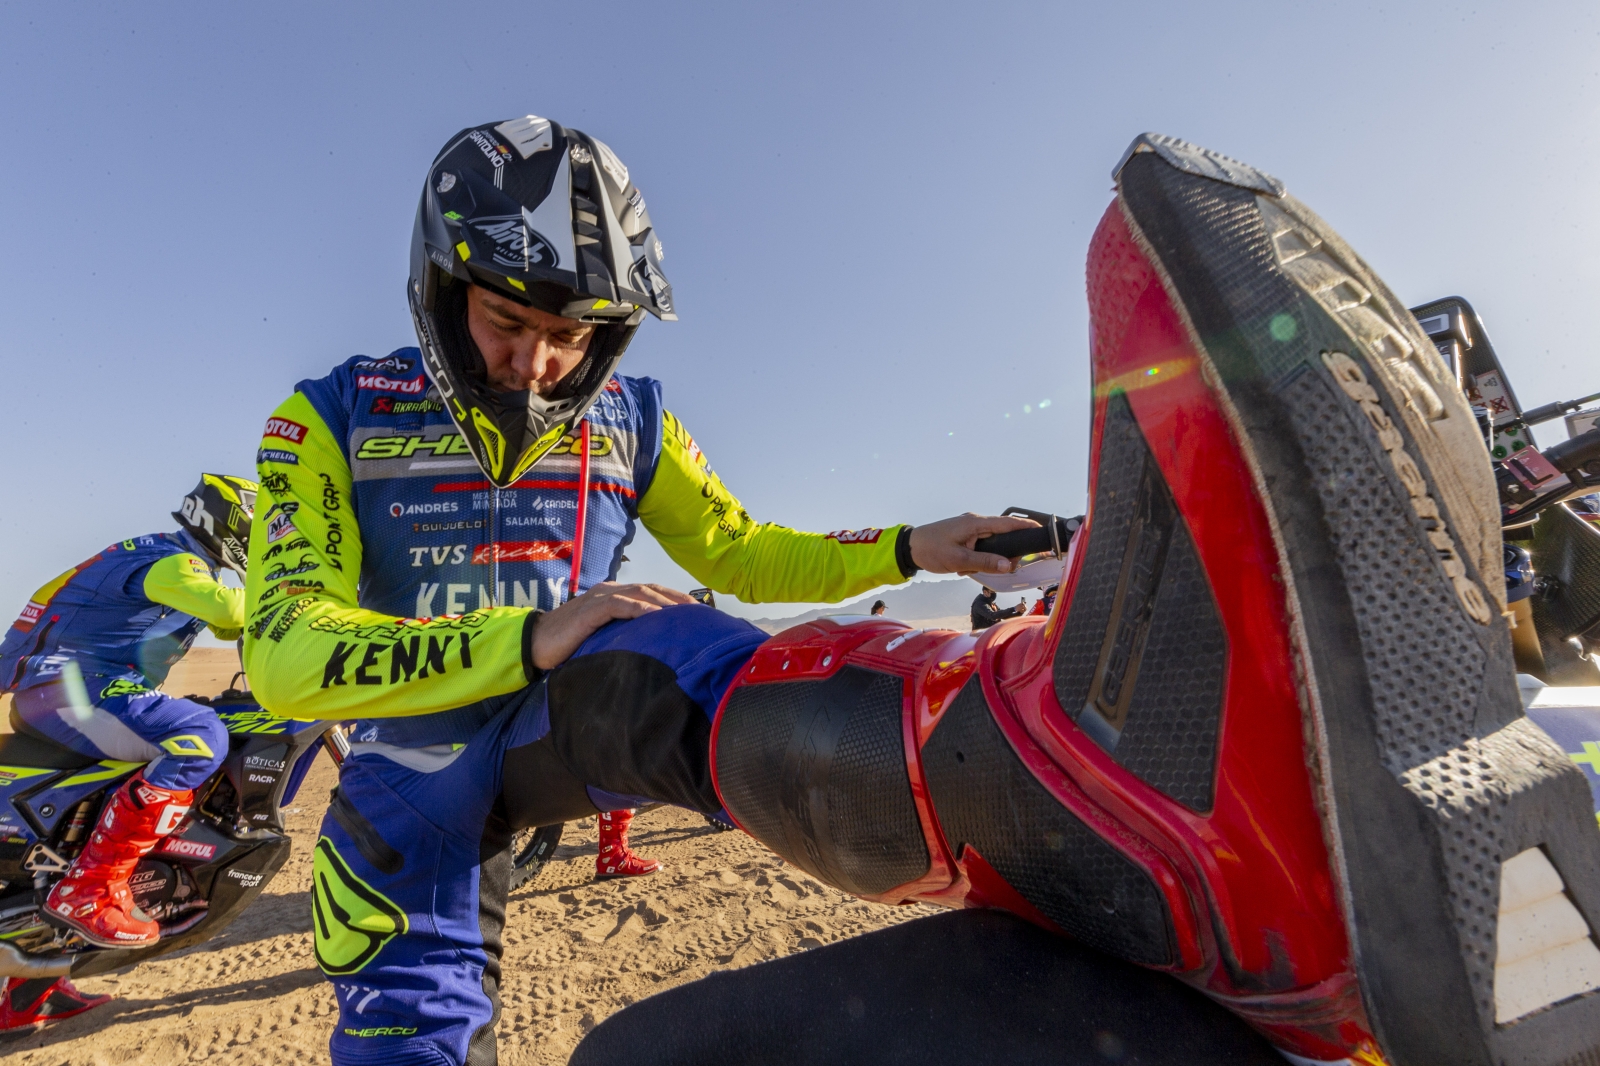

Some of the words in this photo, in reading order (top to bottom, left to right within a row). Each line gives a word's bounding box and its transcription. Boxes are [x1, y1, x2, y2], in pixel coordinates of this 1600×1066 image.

[470, 130, 505, 168] SANTOLINO
[430, 250, 454, 271] AIROH
[357, 376, 422, 393] MOTUL
[263, 419, 301, 441] OTUL
[355, 434, 614, 460] SHECO
[1320, 350, 1493, 626] gaerne
[405, 502, 459, 514] ANDRÉS
[421, 520, 483, 533] GUIJUELO
[505, 517, 563, 527] SALAMANCA
[409, 544, 467, 567] TVS
[320, 630, 483, 689] KENNY
[165, 840, 213, 858] MOTUL
[344, 1026, 418, 1038] SHERCO
